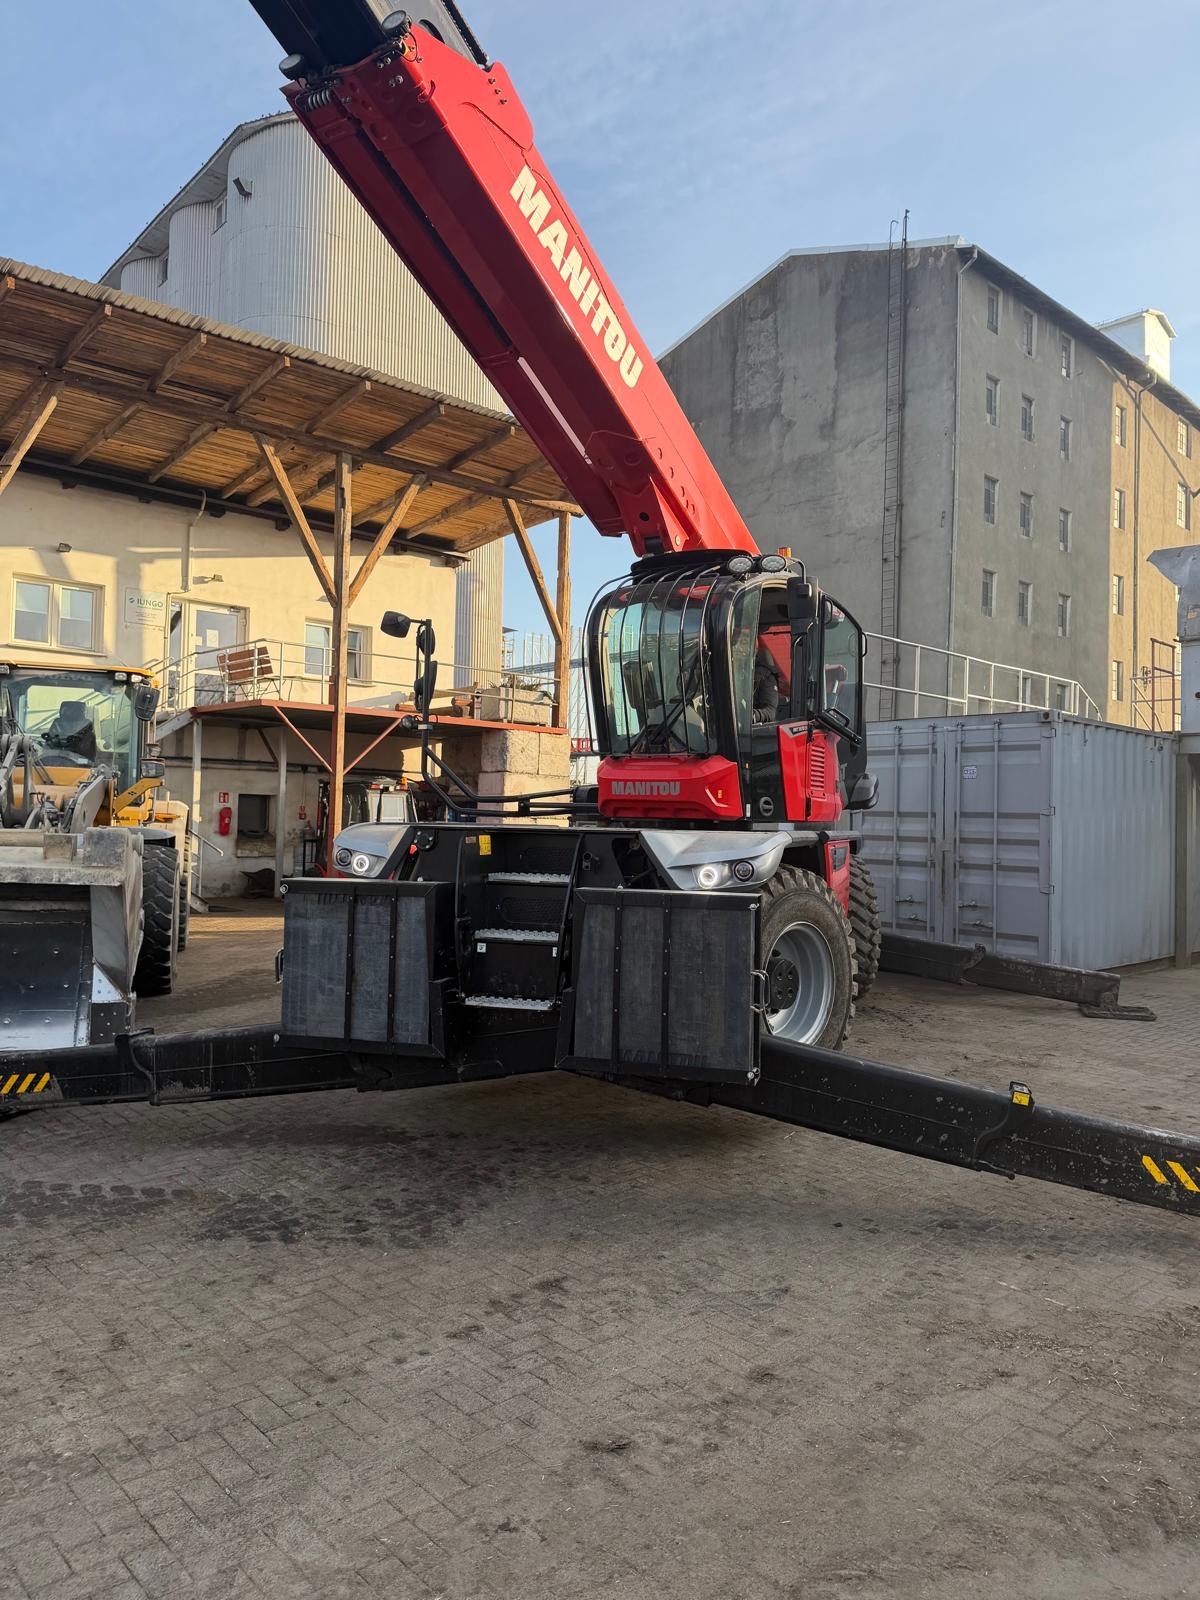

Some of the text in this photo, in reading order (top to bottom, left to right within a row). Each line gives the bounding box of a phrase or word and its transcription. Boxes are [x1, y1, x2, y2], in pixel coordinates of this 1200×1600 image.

[509, 164, 644, 389] MANITOU
[137, 598, 164, 608] IUNGO
[611, 781, 680, 796] MANITOU
